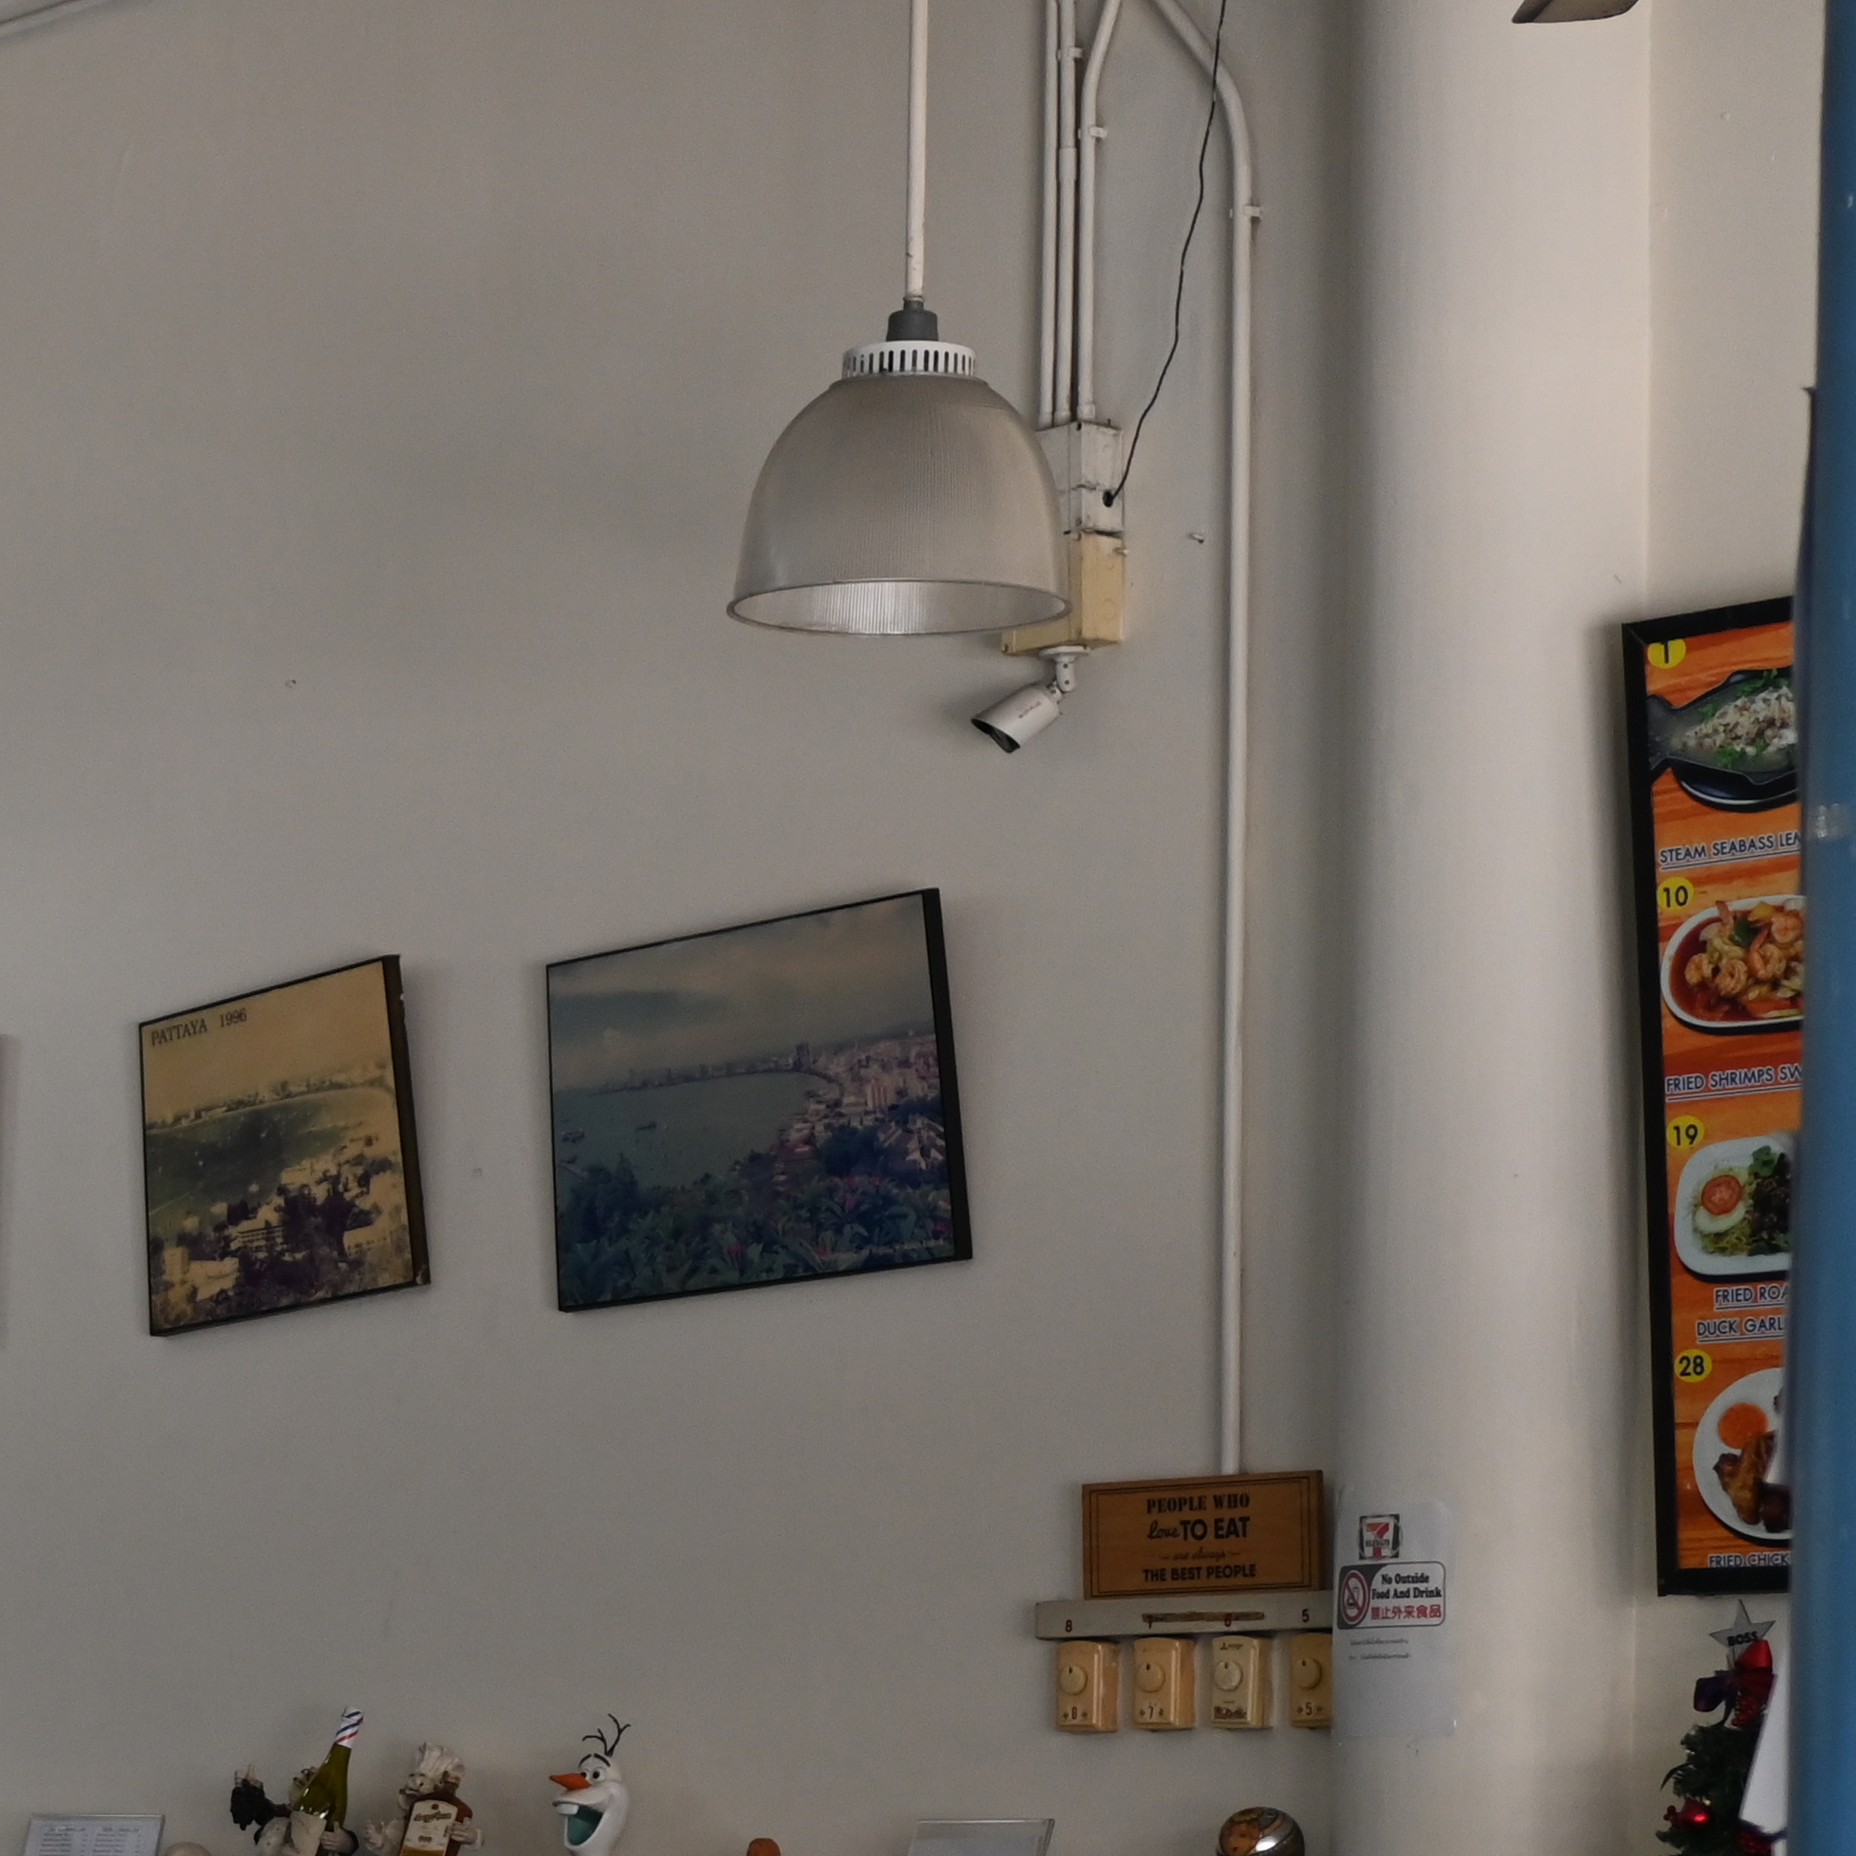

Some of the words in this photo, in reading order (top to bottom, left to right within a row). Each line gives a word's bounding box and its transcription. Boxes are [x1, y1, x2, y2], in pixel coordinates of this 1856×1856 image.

[1659, 845, 1706, 864] STEAM
[1712, 835, 1774, 858] SEABASS
[1663, 885, 1689, 909] 10
[151, 1017, 209, 1047] PATTAYA
[219, 1007, 248, 1028] 1996
[1666, 1075, 1704, 1093] FRIED
[1709, 1066, 1773, 1089] SHRIMPS
[1673, 1123, 1698, 1146] 19
[1715, 1286, 1754, 1304] FRIED
[1696, 1318, 1739, 1336] DUCK
[1678, 1355, 1705, 1377] 28
[1146, 1495, 1207, 1515] PEOPLE
[1212, 1492, 1251, 1510] WHO
[1146, 1519, 1181, 1541] love
[1180, 1518, 1209, 1542] TO
[1214, 1516, 1251, 1540] EAT
[1709, 1554, 1744, 1567] FRIED
[1142, 1568, 1168, 1583] THE
[1170, 1566, 1204, 1581] BEST
[1205, 1563, 1257, 1580] PEOPLE
[1381, 1573, 1393, 1585] No
[1394, 1572, 1430, 1585] Outside
[1372, 1588, 1391, 1601] Food
[1391, 1588, 1411, 1600] And
[1412, 1587, 1443, 1599] Drink
[1301, 1608, 1311, 1623] 5
[1065, 1620, 1073, 1633] 8
[1726, 1630, 1759, 1647] BOSS
